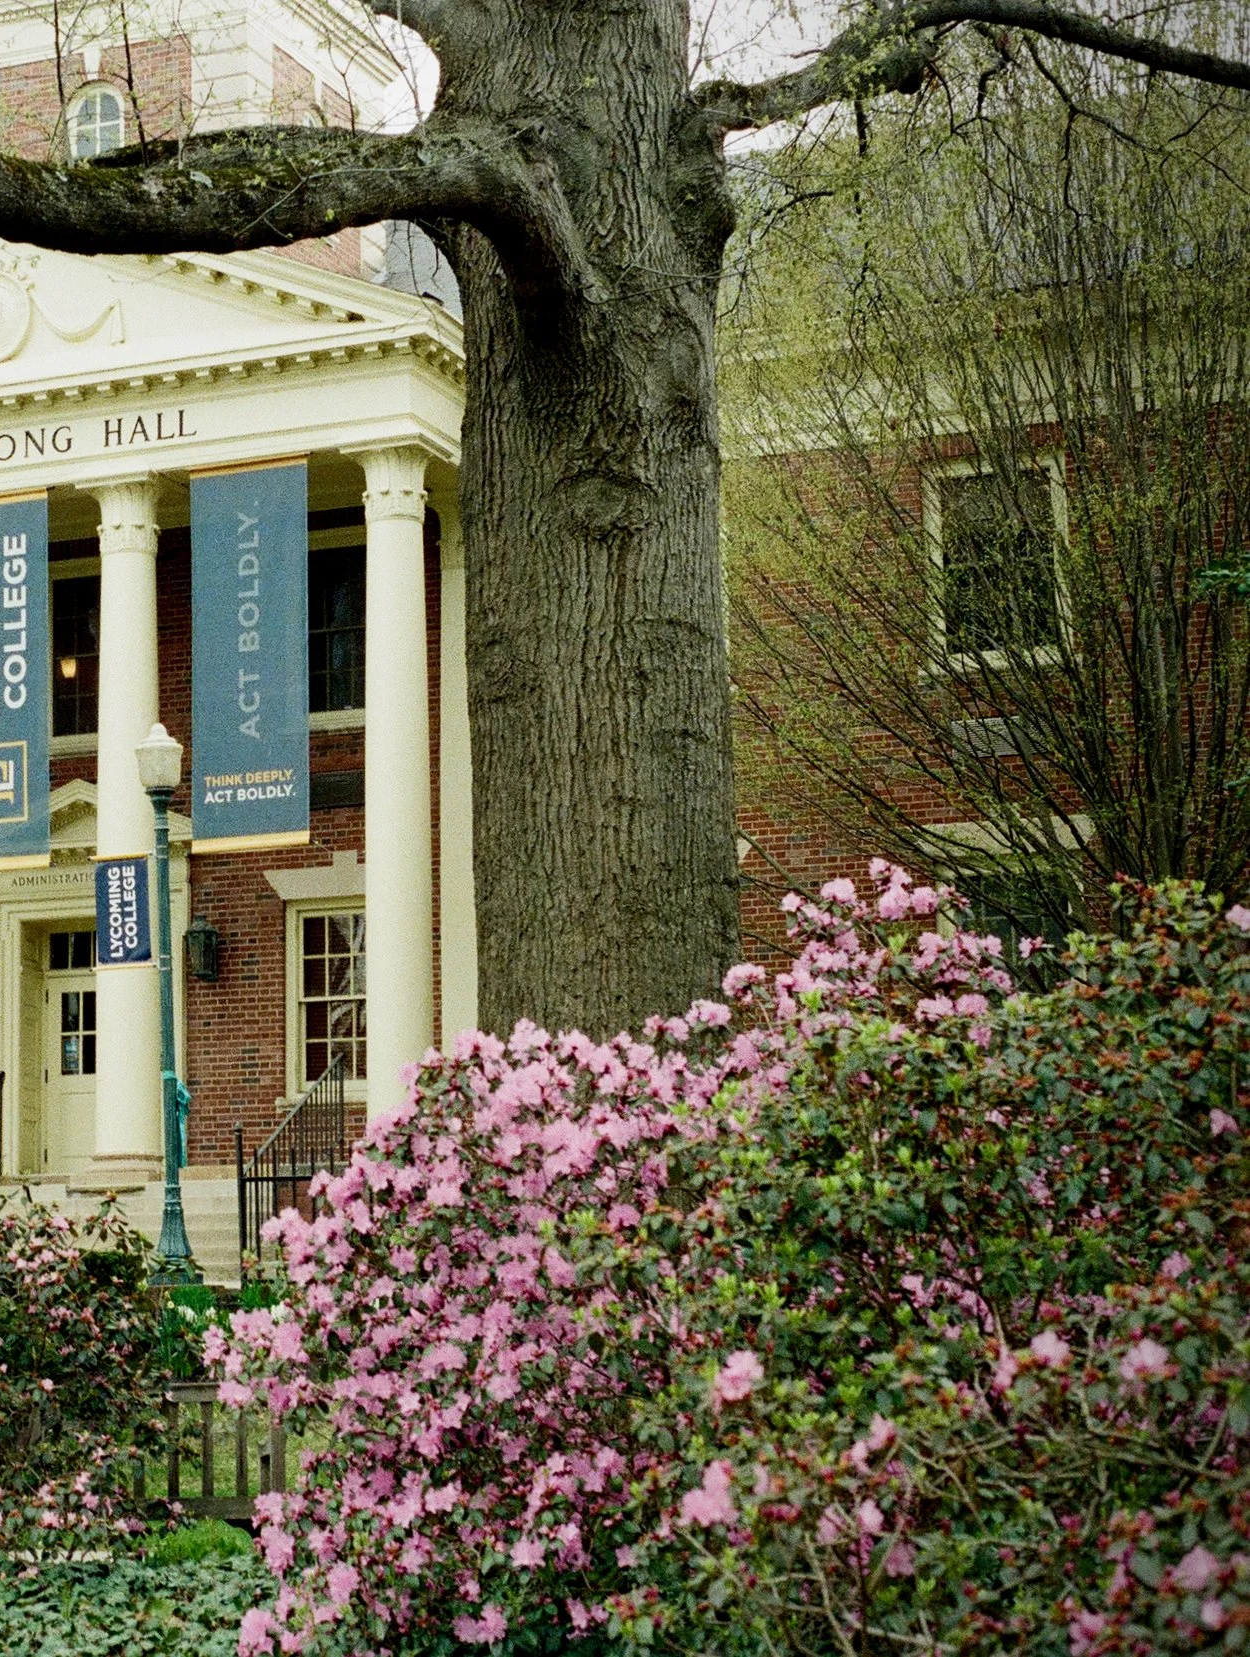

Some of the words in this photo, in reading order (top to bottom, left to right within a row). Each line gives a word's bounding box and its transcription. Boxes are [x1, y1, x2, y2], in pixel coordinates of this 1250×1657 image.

[103, 409, 197, 447] HALL
[2, 532, 27, 710] COLLEGE
[238, 668, 261, 740] ACT
[204, 773, 243, 788] THINK
[204, 789, 233, 804] ACT
[236, 784, 296, 801] BOLDLY.
[107, 866, 124, 958] LYCOMING
[122, 865, 138, 949] COLLEGE
